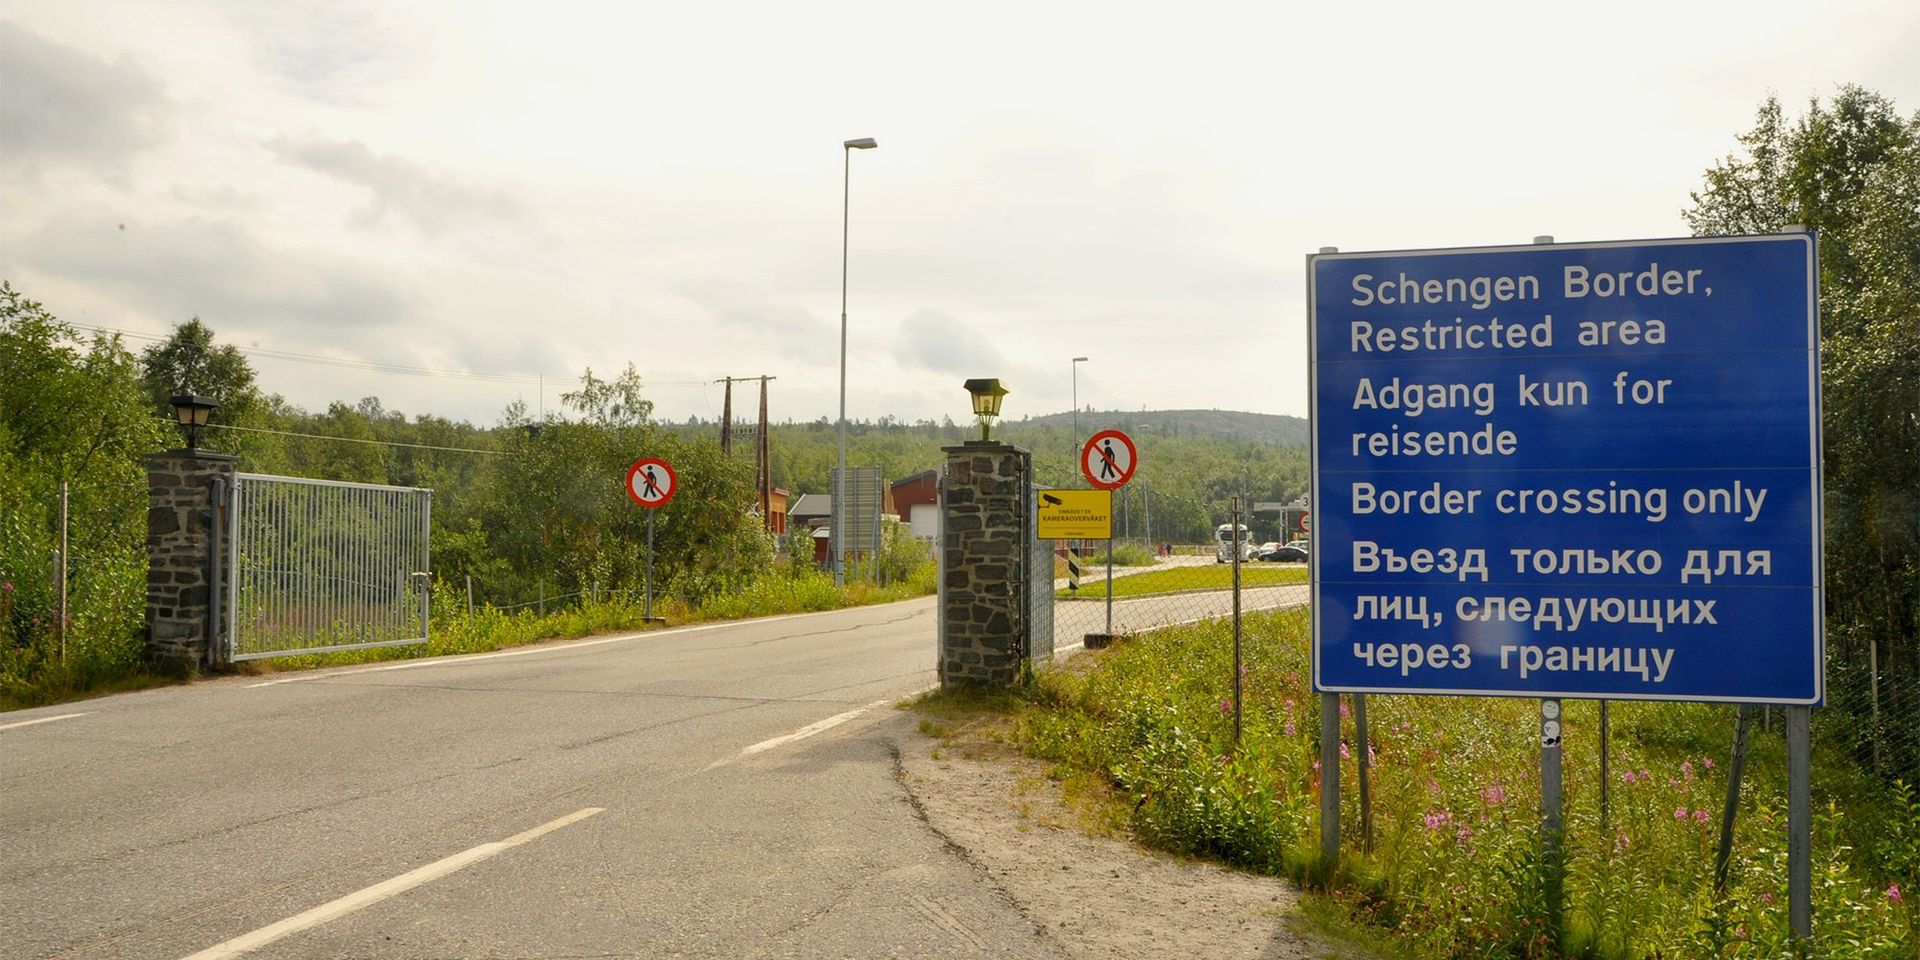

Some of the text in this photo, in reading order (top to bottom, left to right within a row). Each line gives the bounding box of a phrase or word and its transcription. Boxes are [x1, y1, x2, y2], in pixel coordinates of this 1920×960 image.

[1352, 263, 1712, 309] Schengen Border,
[1352, 315, 1665, 352] Restricted area
[1353, 372, 1672, 416] Adgang kun for
[1353, 423, 1517, 456] reisende
[1353, 481, 1767, 522] Border crossing only
[1353, 541, 1770, 584] Въезд только для
[1354, 596, 1718, 633] лиц, следующих
[1354, 643, 1675, 683] через границу
